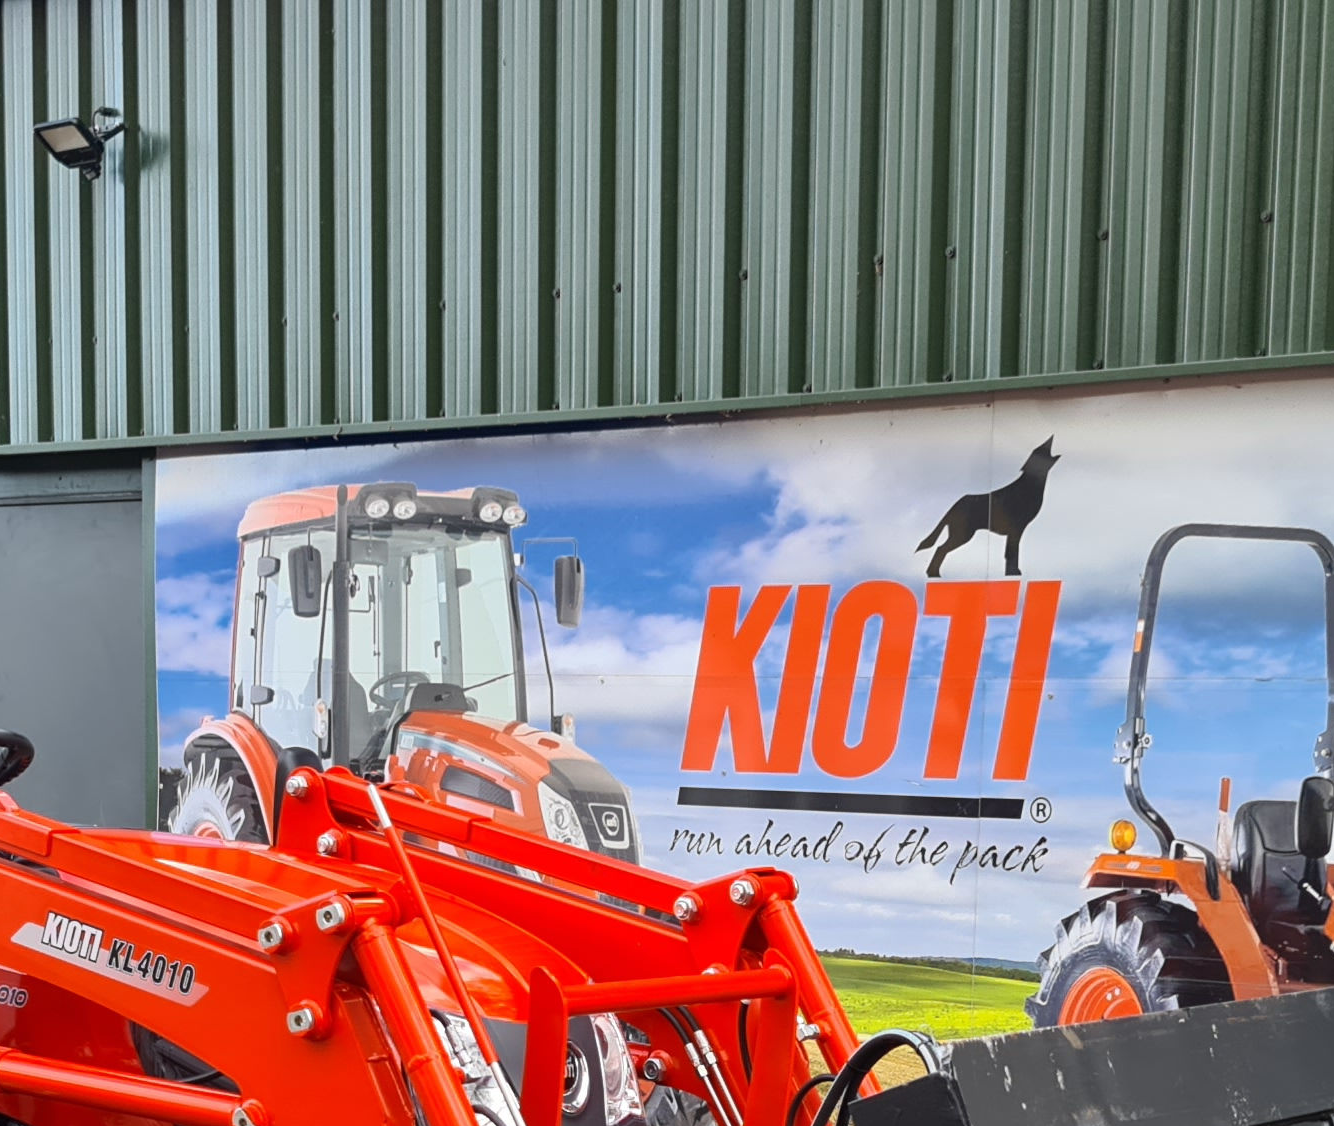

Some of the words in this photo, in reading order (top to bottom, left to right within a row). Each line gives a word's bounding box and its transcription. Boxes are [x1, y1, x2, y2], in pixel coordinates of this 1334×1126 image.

[680, 580, 1062, 781] KIOTI
[668, 826, 724, 855] run
[734, 819, 844, 862] ahead
[844, 823, 896, 873] of
[895, 826, 946, 866] the
[949, 835, 1050, 885] pack
[41, 911, 103, 963] KIOTI
[107, 938, 195, 994] KL4010
